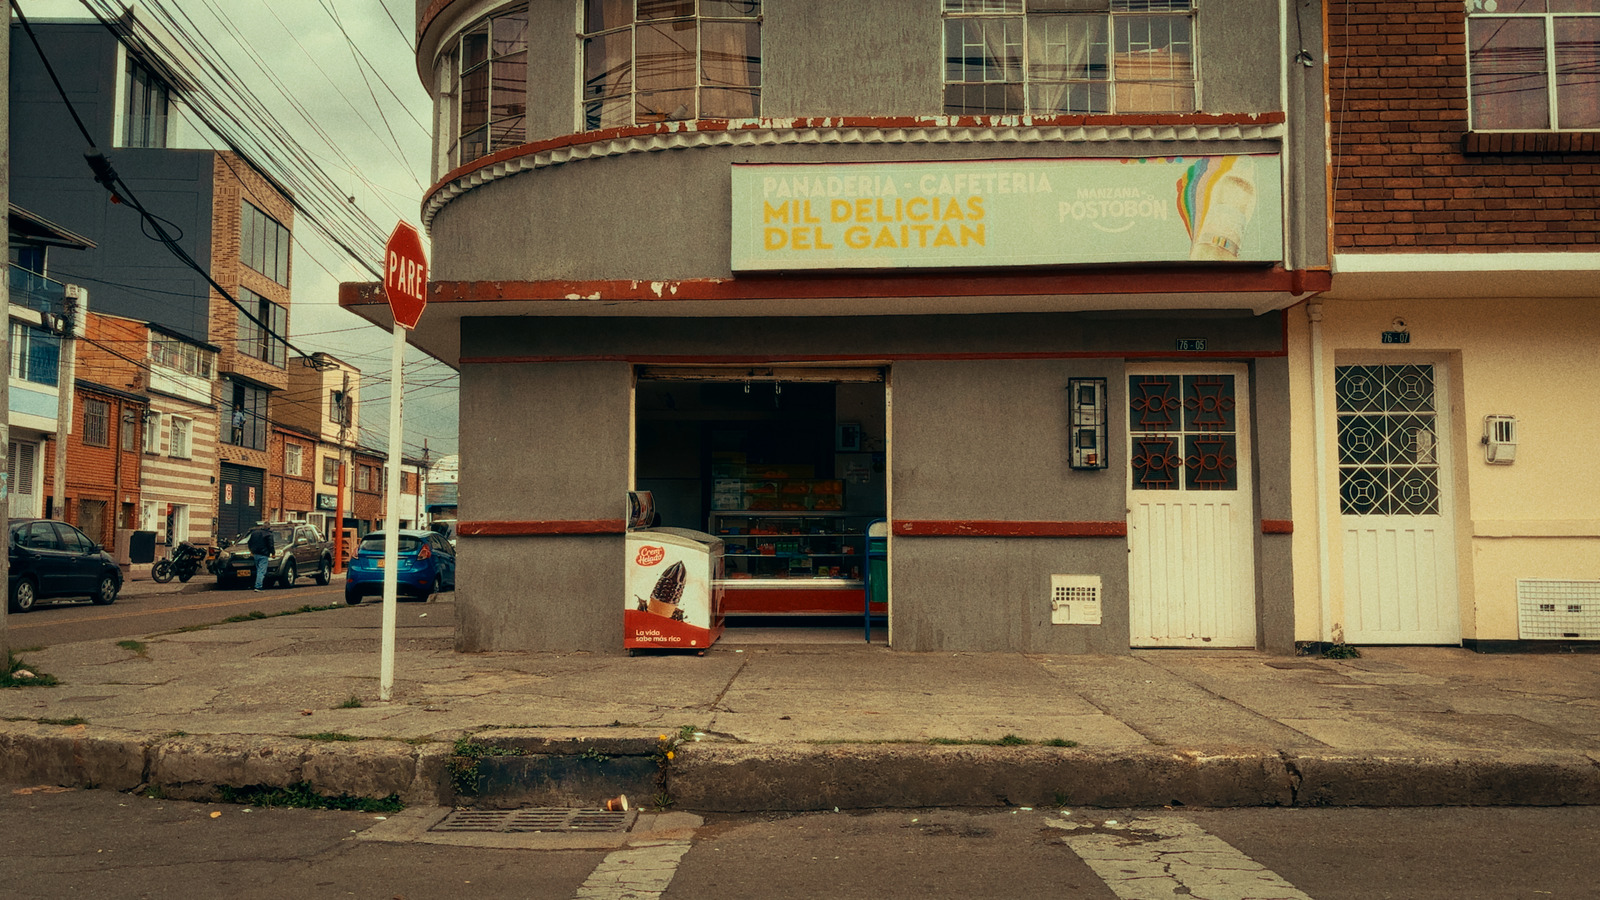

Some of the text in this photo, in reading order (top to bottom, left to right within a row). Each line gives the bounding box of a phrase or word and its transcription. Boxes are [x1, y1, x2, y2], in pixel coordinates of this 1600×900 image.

[763, 174, 899, 198] PANADERIA
[919, 172, 1053, 195] CAFETERIA
[1076, 187, 1140, 199] MANZANA
[763, 196, 986, 224] MIL DELICIAS
[763, 223, 986, 251] DEL GAITAN
[388, 250, 424, 301] PARE
